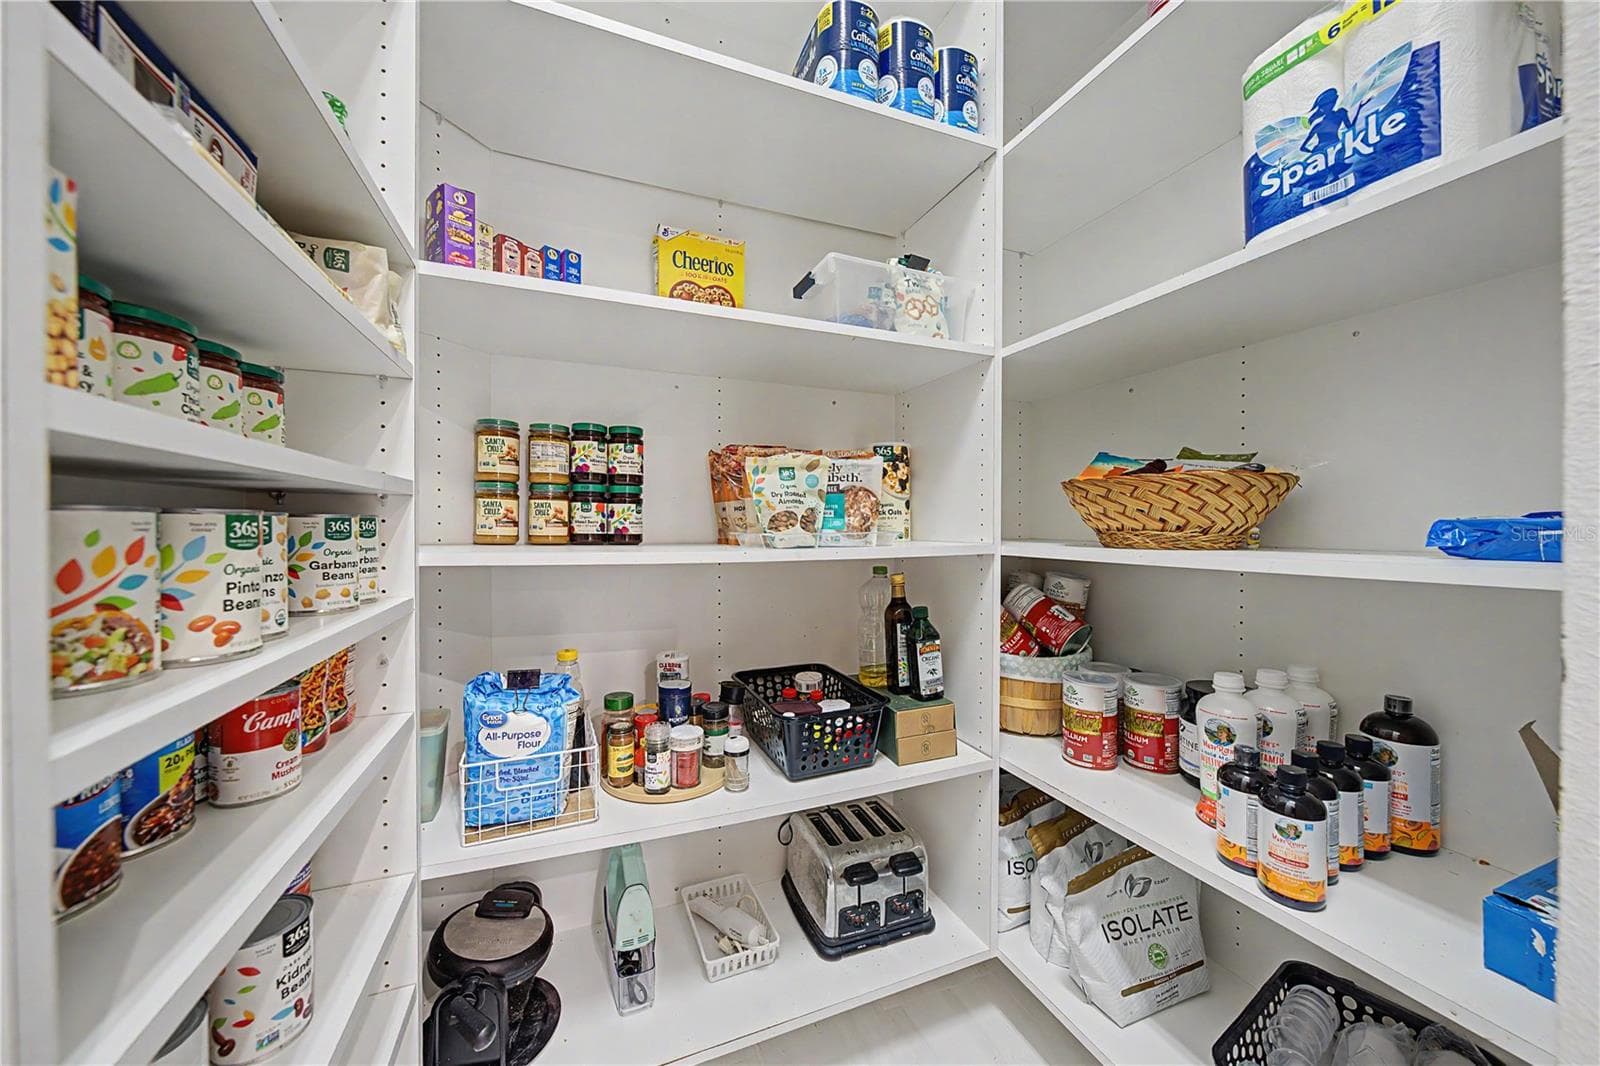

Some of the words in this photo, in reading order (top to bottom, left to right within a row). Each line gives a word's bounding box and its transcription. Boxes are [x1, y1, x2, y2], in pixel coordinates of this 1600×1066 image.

[1327, 22, 1341, 39] 6
[851, 29, 879, 51] Cotton
[1260, 110, 1407, 198] Sparkle
[672, 249, 734, 277] Cheerios
[484, 437, 506, 446] SANTA
[486, 444, 504, 453] CRUZ
[874, 446, 892, 456] 365
[771, 491, 784, 500] Dry
[482, 501, 503, 509] SANTA
[533, 501, 552, 510] SANTA
[483, 507, 501, 516] CRUZ
[229, 520, 259, 539] 365
[327, 520, 351, 533] 365
[359, 520, 377, 532] 365
[323, 547, 352, 558] Organic
[223, 563, 260, 578] Organi
[308, 560, 359, 571] Garbanzo
[322, 571, 355, 581] Beans
[226, 580, 260, 595] Pinto
[223, 598, 260, 612] Bean
[242, 707, 300, 734] Camp
[481, 713, 503, 722] Great
[485, 730, 542, 742] All-Purpose
[517, 740, 541, 750] Flour
[1100, 901, 1193, 944] ISOLATE
[285, 922, 310, 949] 365
[1123, 937, 1144, 947] WHEY
[1146, 926, 1181, 939] PROTEIN
